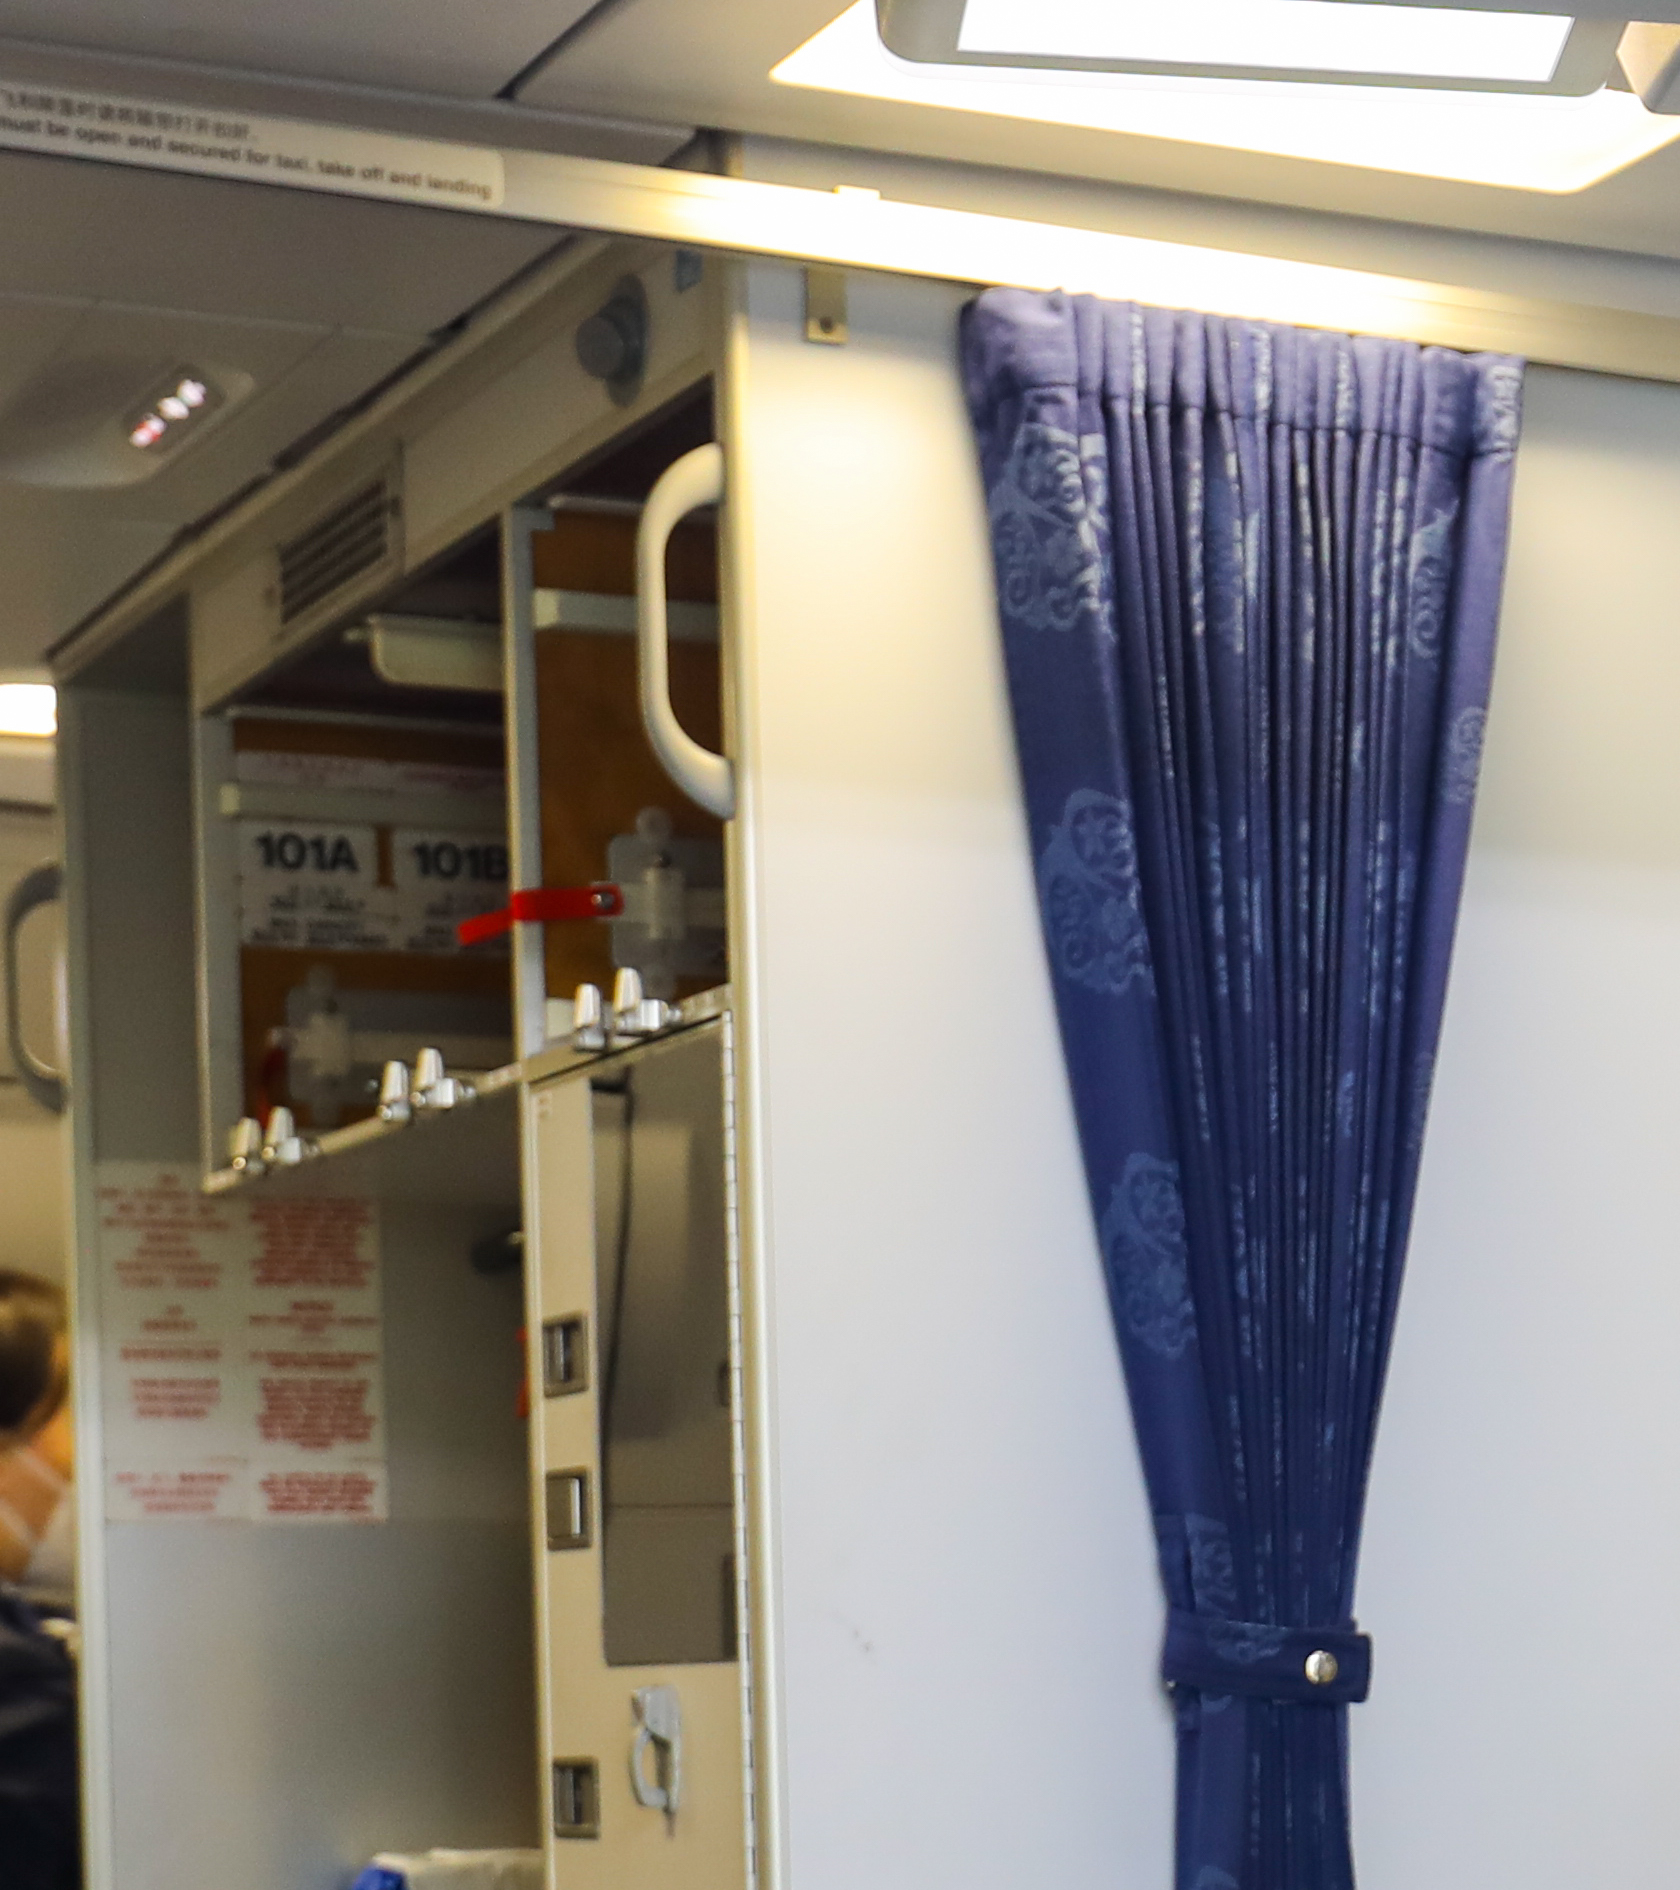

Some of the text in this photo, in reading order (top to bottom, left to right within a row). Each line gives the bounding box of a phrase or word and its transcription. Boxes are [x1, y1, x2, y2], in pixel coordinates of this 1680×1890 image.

[47, 120, 67, 137] be
[74, 126, 121, 146] open
[128, 134, 163, 151] and
[168, 138, 242, 163] secured
[246, 148, 270, 166] for
[318, 159, 356, 179] take
[361, 164, 385, 181] off
[389, 170, 422, 188] and
[253, 832, 360, 873] 101A
[413, 841, 510, 882] 101B
